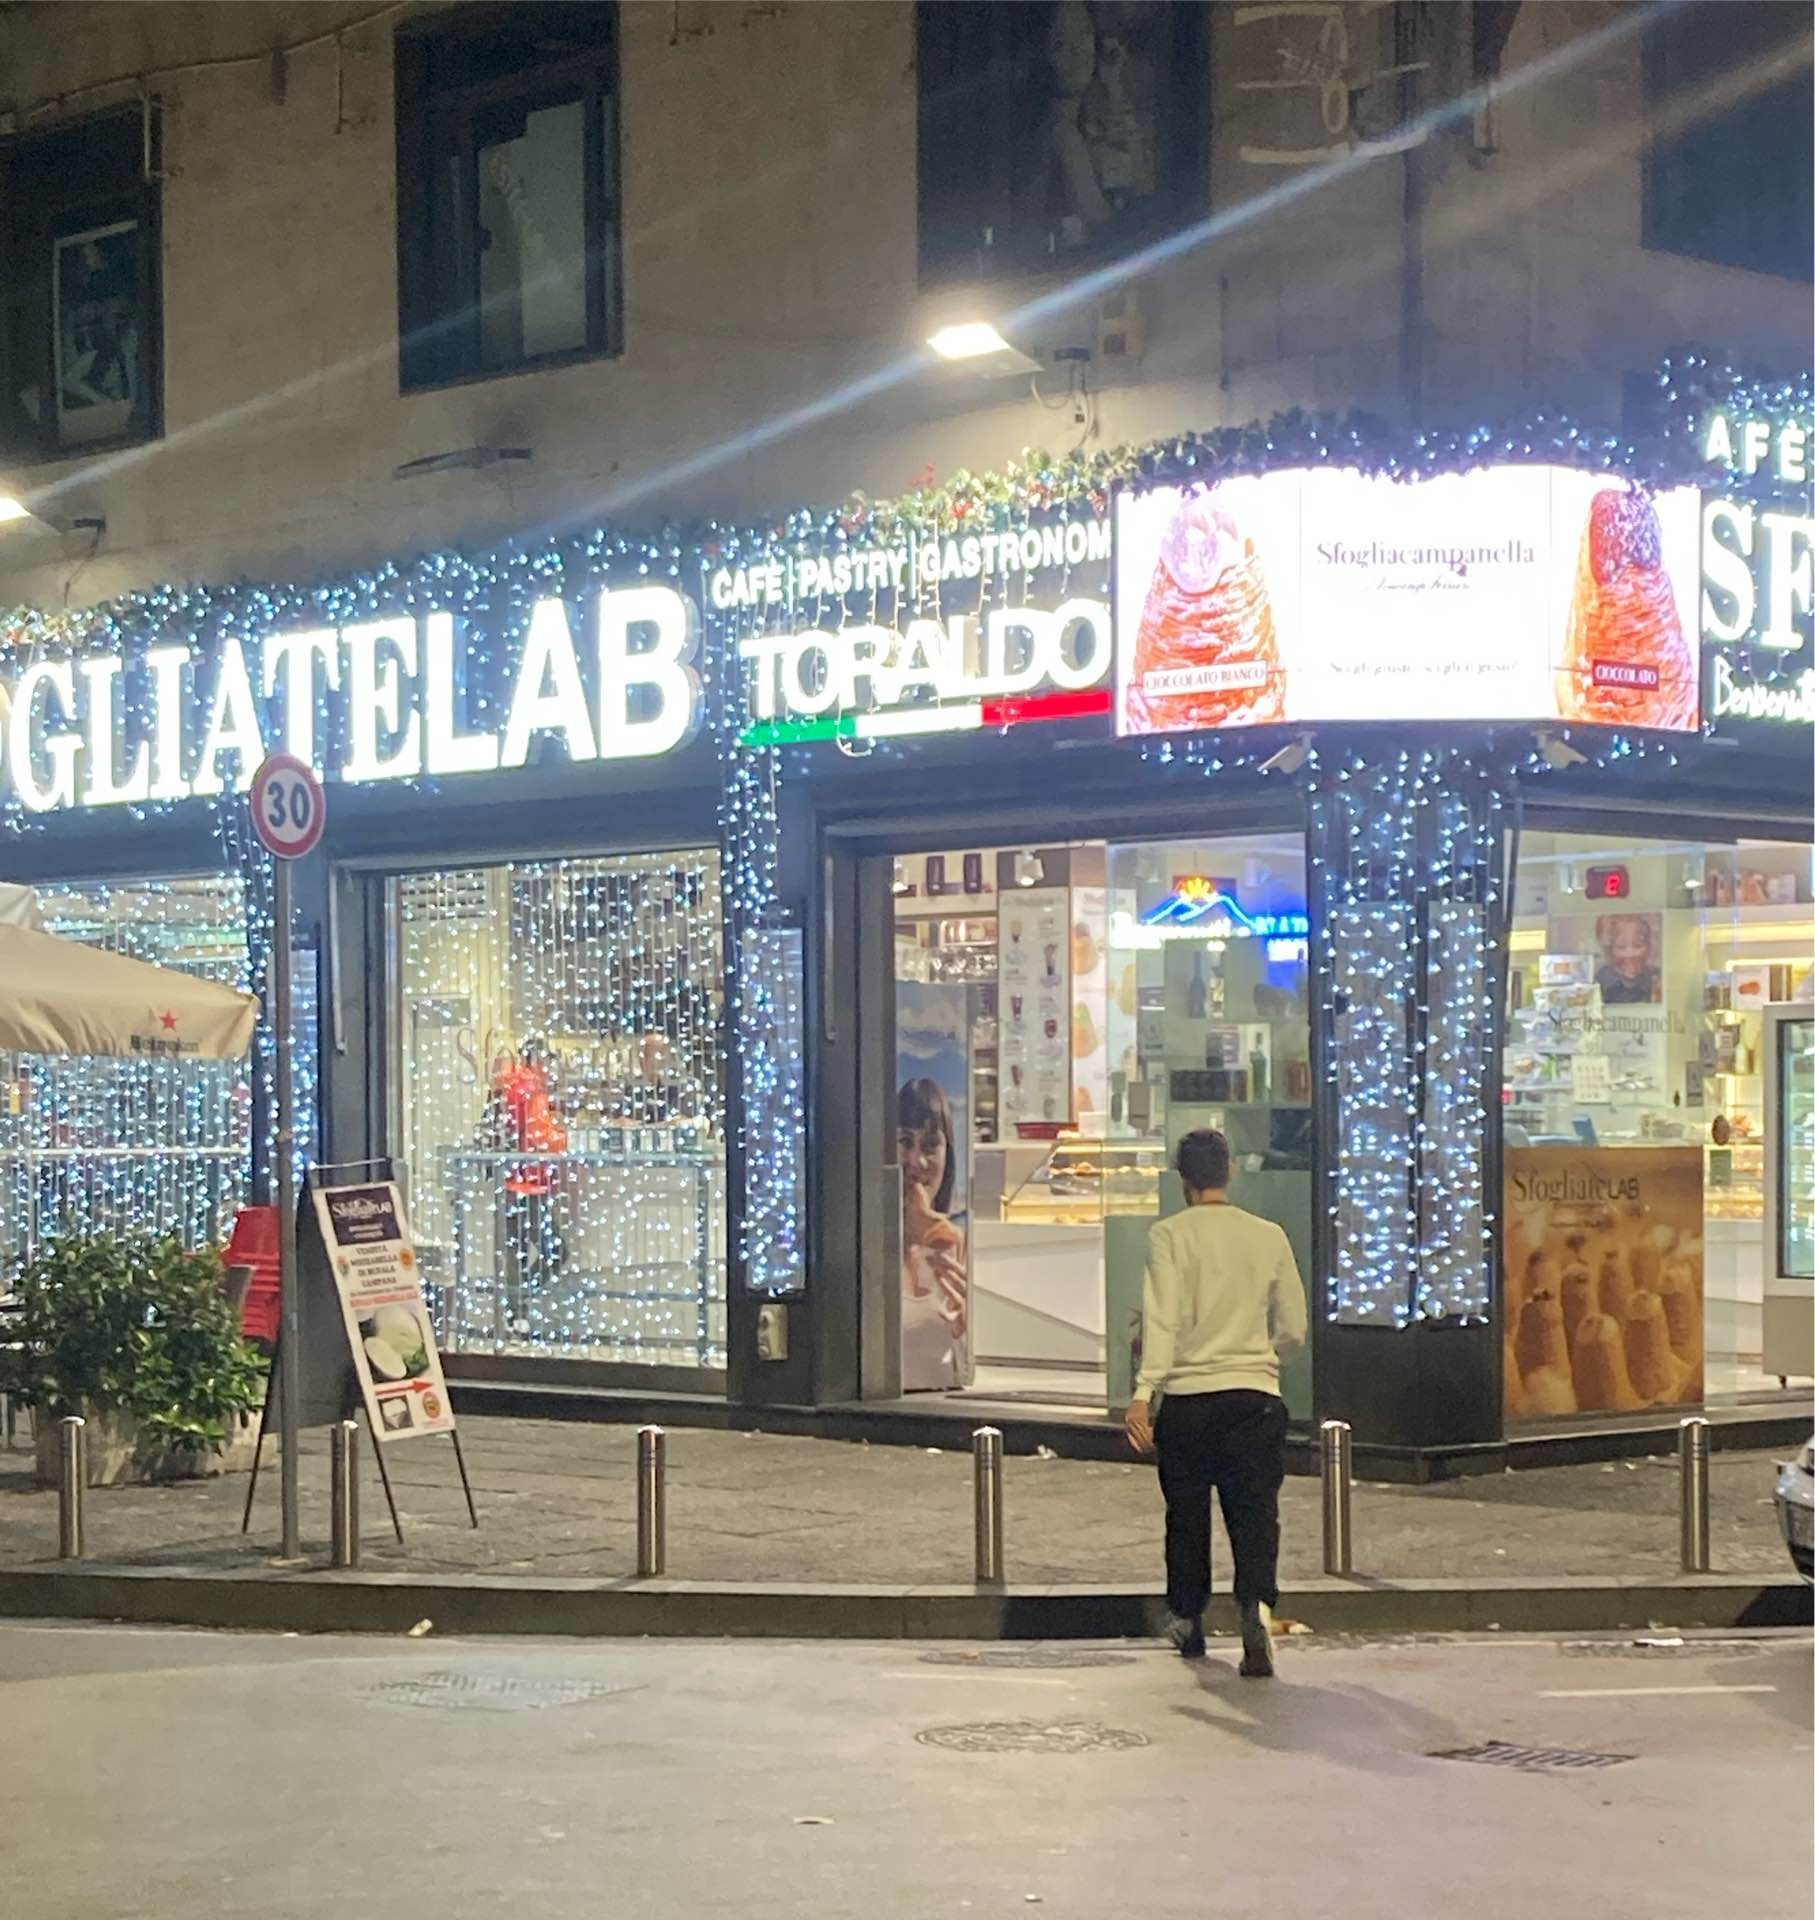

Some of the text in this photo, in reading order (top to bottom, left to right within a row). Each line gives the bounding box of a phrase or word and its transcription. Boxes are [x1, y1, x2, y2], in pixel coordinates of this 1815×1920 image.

[799, 548, 907, 596] PASTRY
[1316, 540, 1536, 571] Sfogliacampanella
[739, 598, 1112, 718] TORALDO
[1146, 672, 1218, 689] CIOCCOLATO
[0, 585, 694, 812] GLIATELAB
[268, 781, 310, 829] 30
